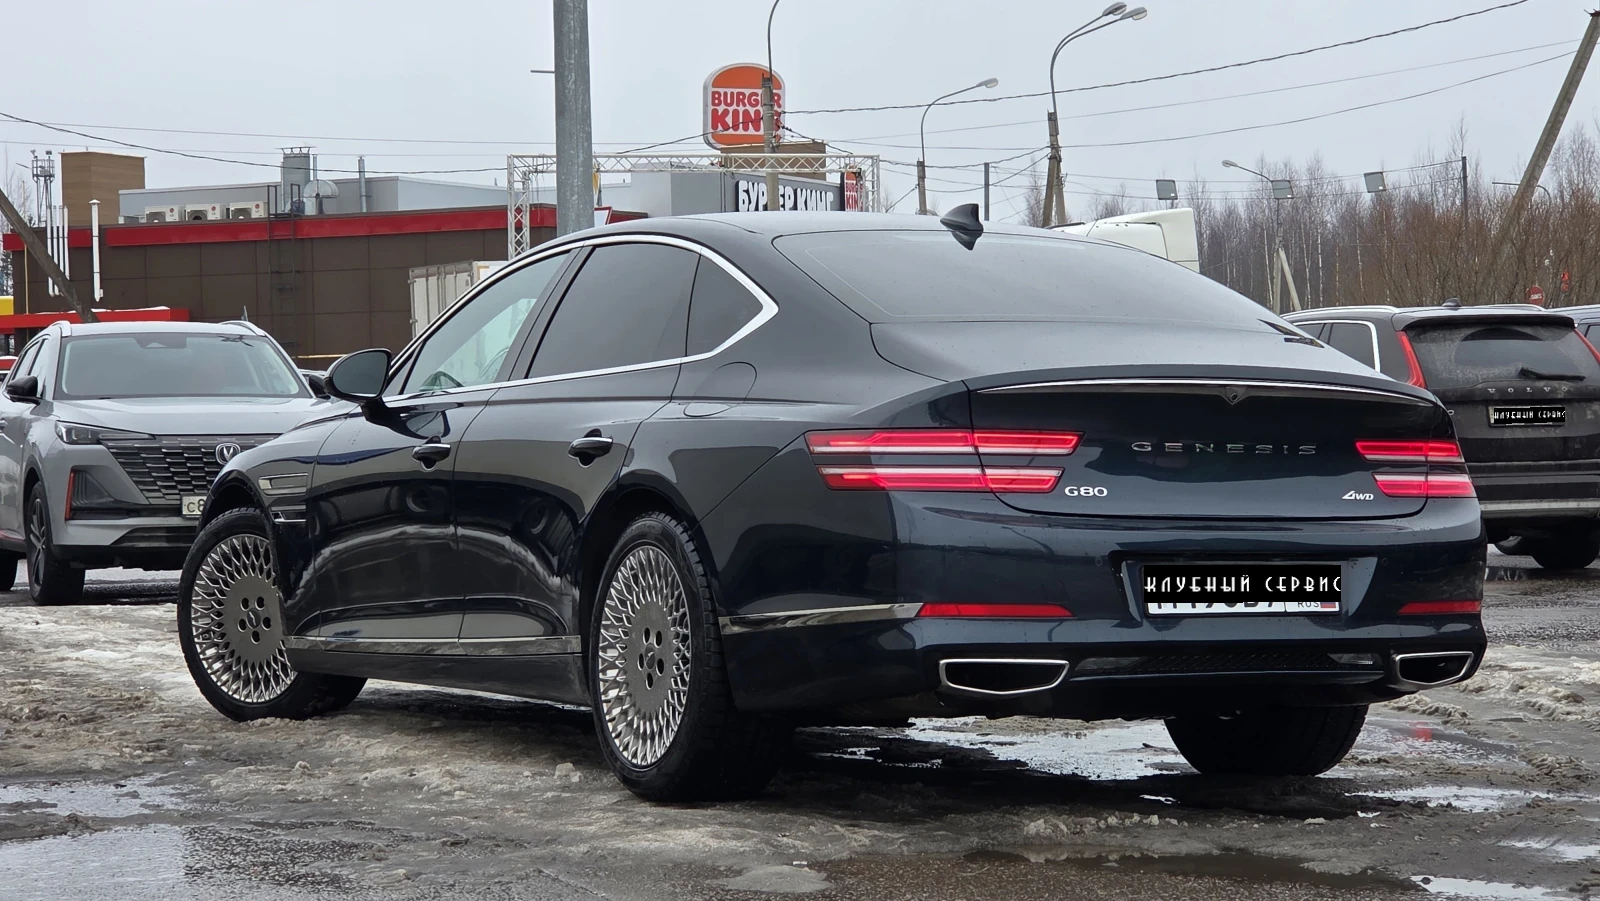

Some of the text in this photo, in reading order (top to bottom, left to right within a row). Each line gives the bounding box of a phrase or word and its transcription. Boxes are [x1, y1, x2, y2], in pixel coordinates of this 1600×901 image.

[711, 90, 782, 108] BURGR
[738, 180, 834, 212] БУРЕР КИНГ
[1131, 441, 1316, 455] GENESIS
[1064, 486, 1108, 497] G80
[1341, 490, 1374, 501] 4WD
